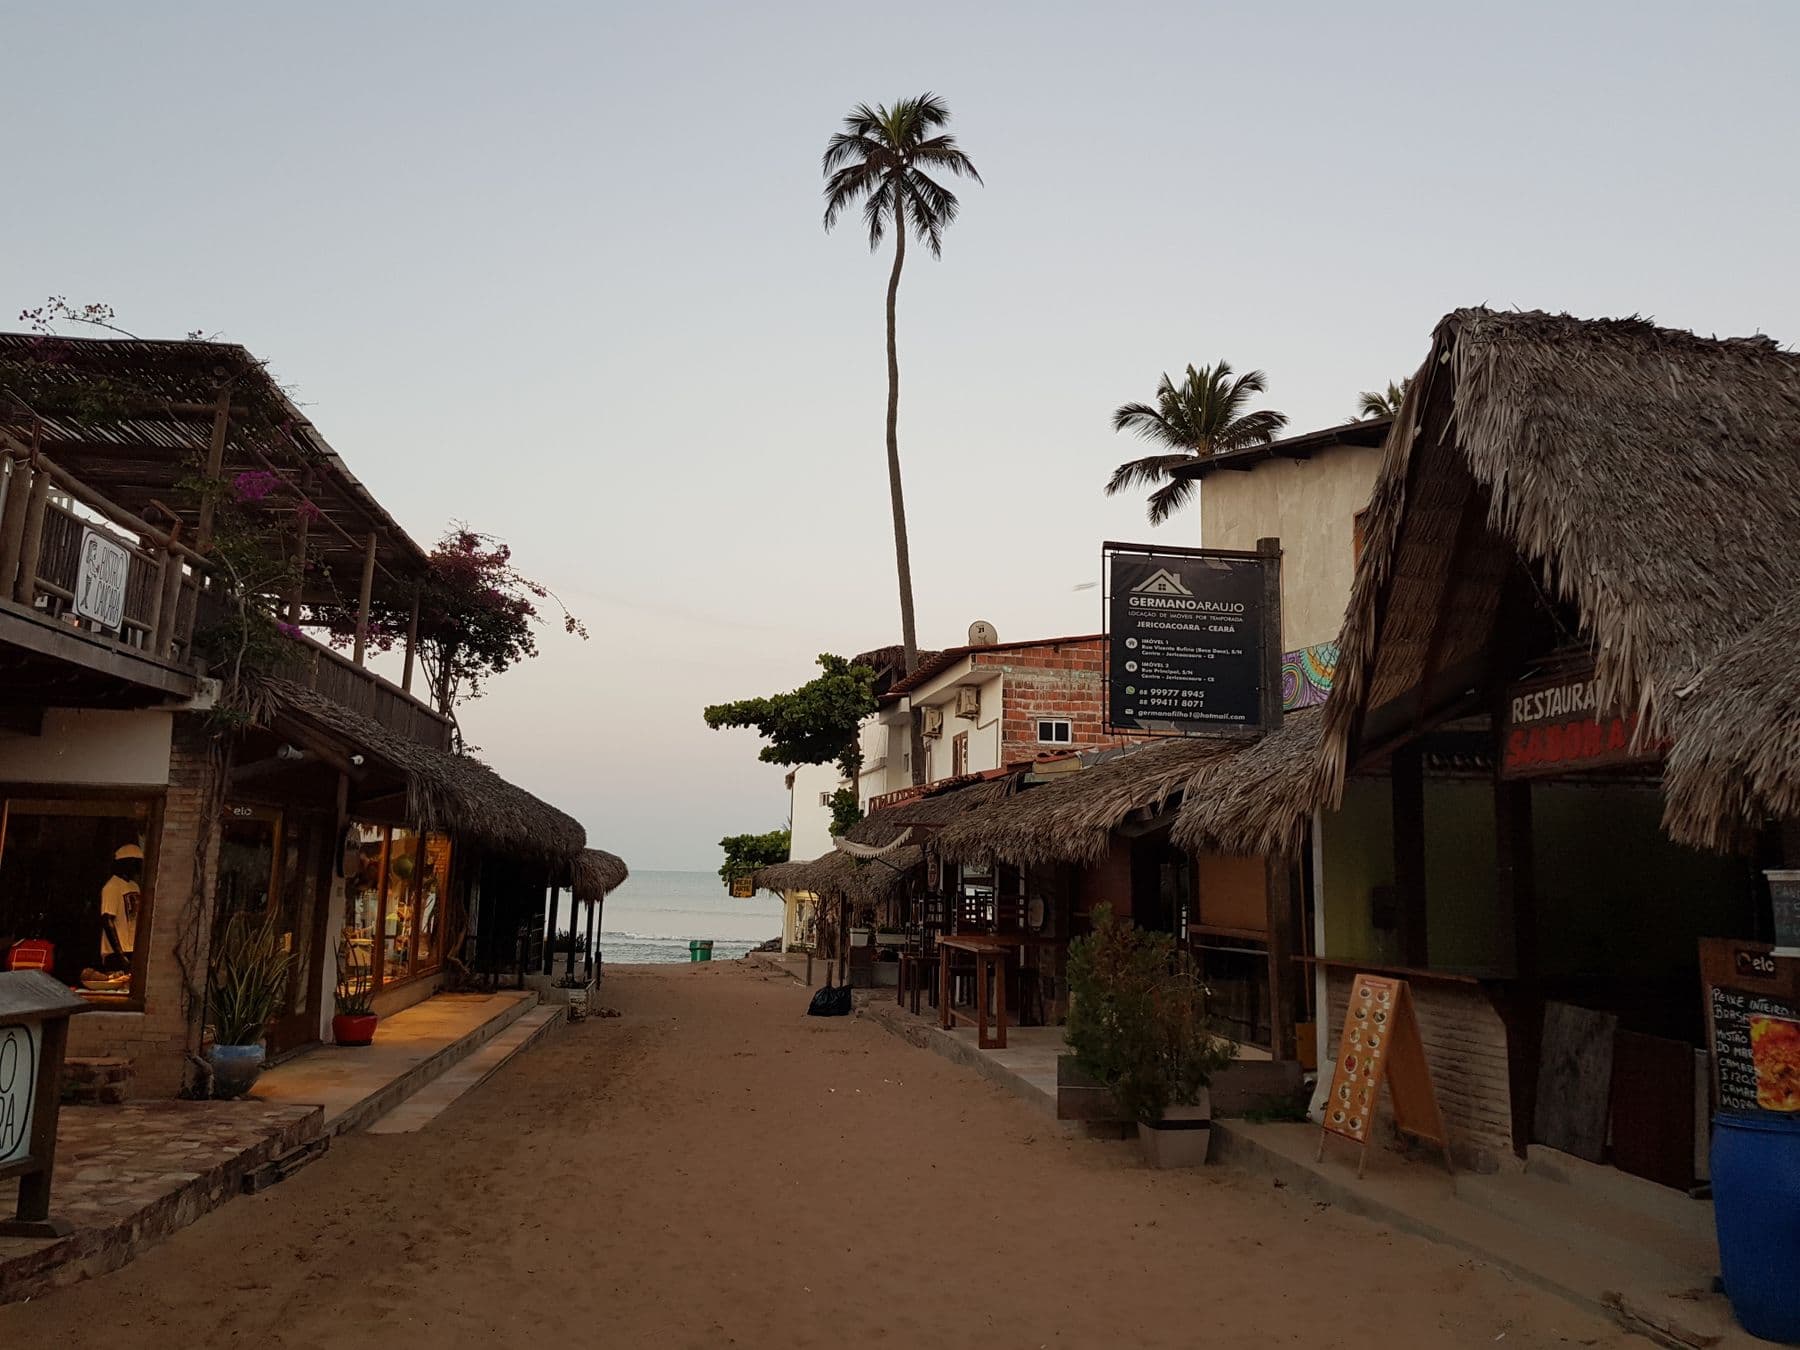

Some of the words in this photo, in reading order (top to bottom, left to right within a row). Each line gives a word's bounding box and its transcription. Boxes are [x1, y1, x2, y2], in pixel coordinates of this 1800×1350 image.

[1128, 609, 1157, 618] LOCAÇÃO
[1170, 612, 1193, 620] IMÓVEIS
[1136, 620, 1201, 632] JERICOACOARA
[1208, 622, 1236, 633] CEARÁ
[1150, 688, 1180, 697] 99977
[1181, 690, 1205, 698] 8945
[1150, 698, 1178, 706] 99411
[1181, 700, 1205, 708] 8071
[1138, 710, 1246, 721] germanofilho1@hotmail.com
[1711, 988, 1744, 1008] PEIXE
[1716, 1040, 1730, 1054] DO
